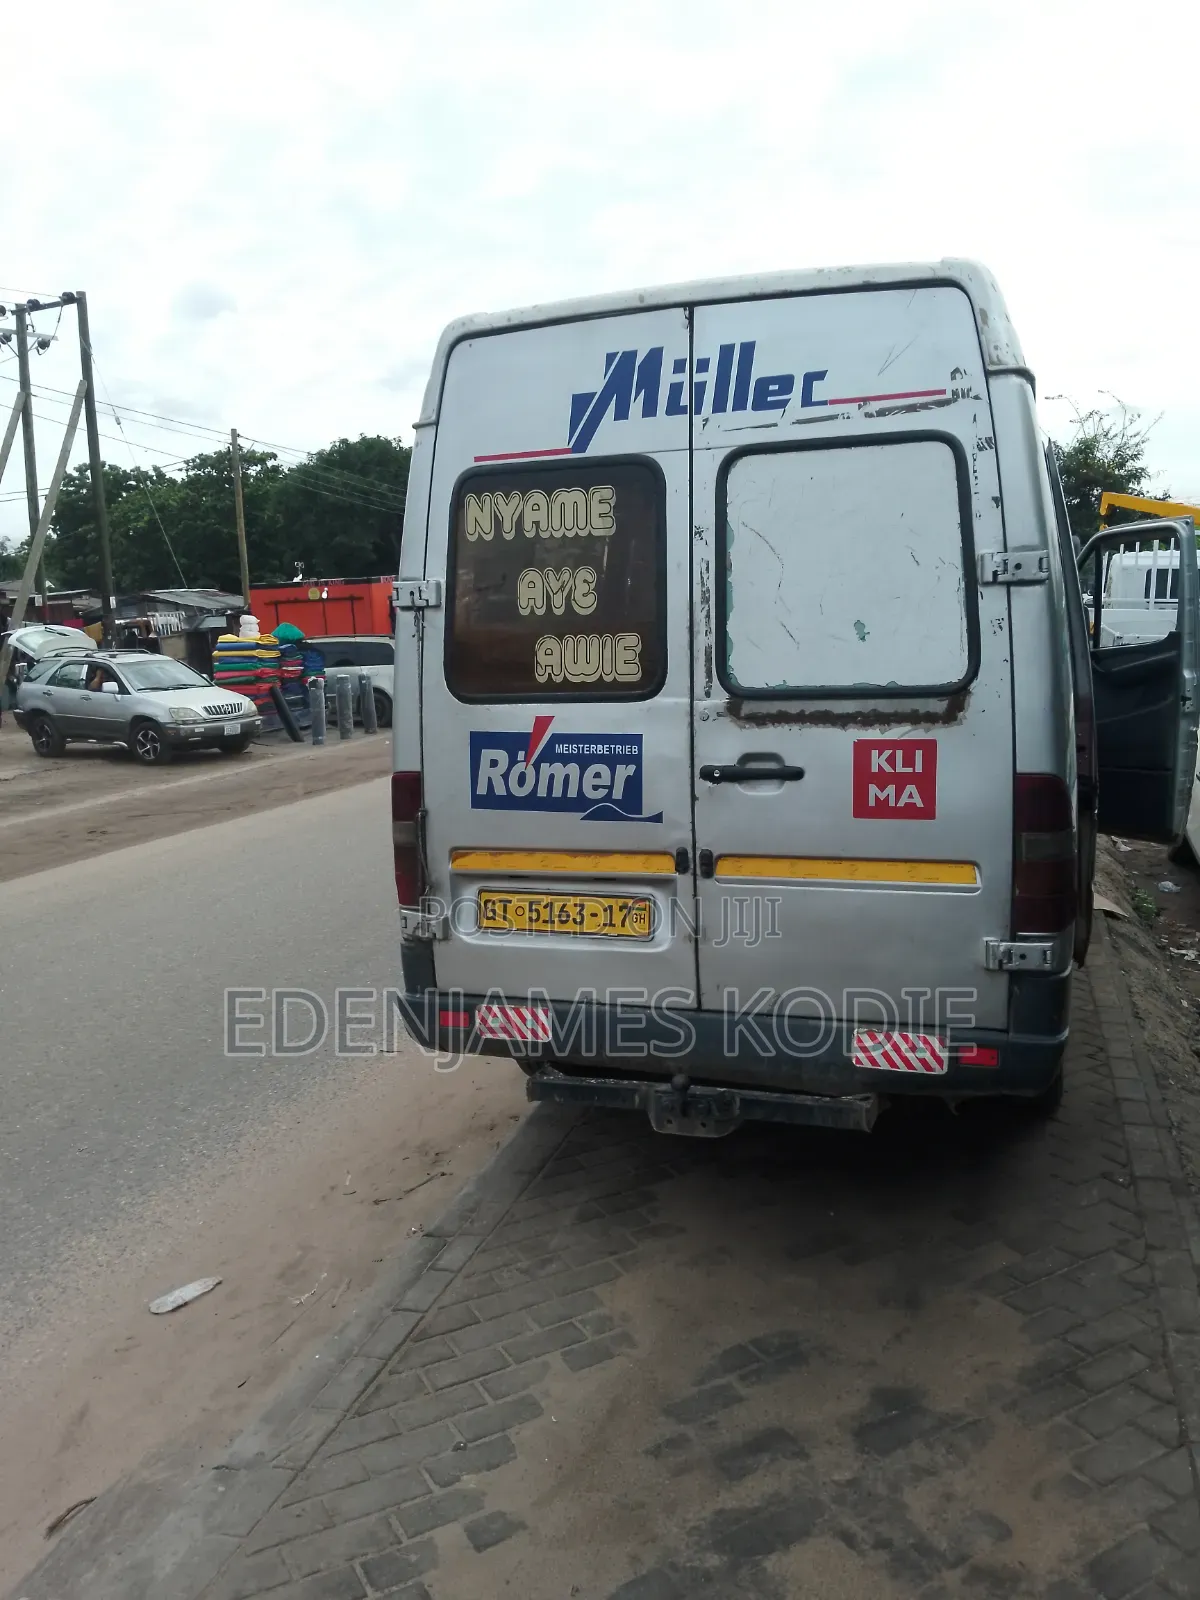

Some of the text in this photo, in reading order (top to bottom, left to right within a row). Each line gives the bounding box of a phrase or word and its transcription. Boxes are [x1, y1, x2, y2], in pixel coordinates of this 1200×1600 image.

[465, 485, 616, 541] NYAME
[535, 632, 642, 683] AWIE
[555, 743, 639, 755] MEISTERBETRIEB
[871, 749, 923, 773] KLI
[868, 783, 925, 808] MA
